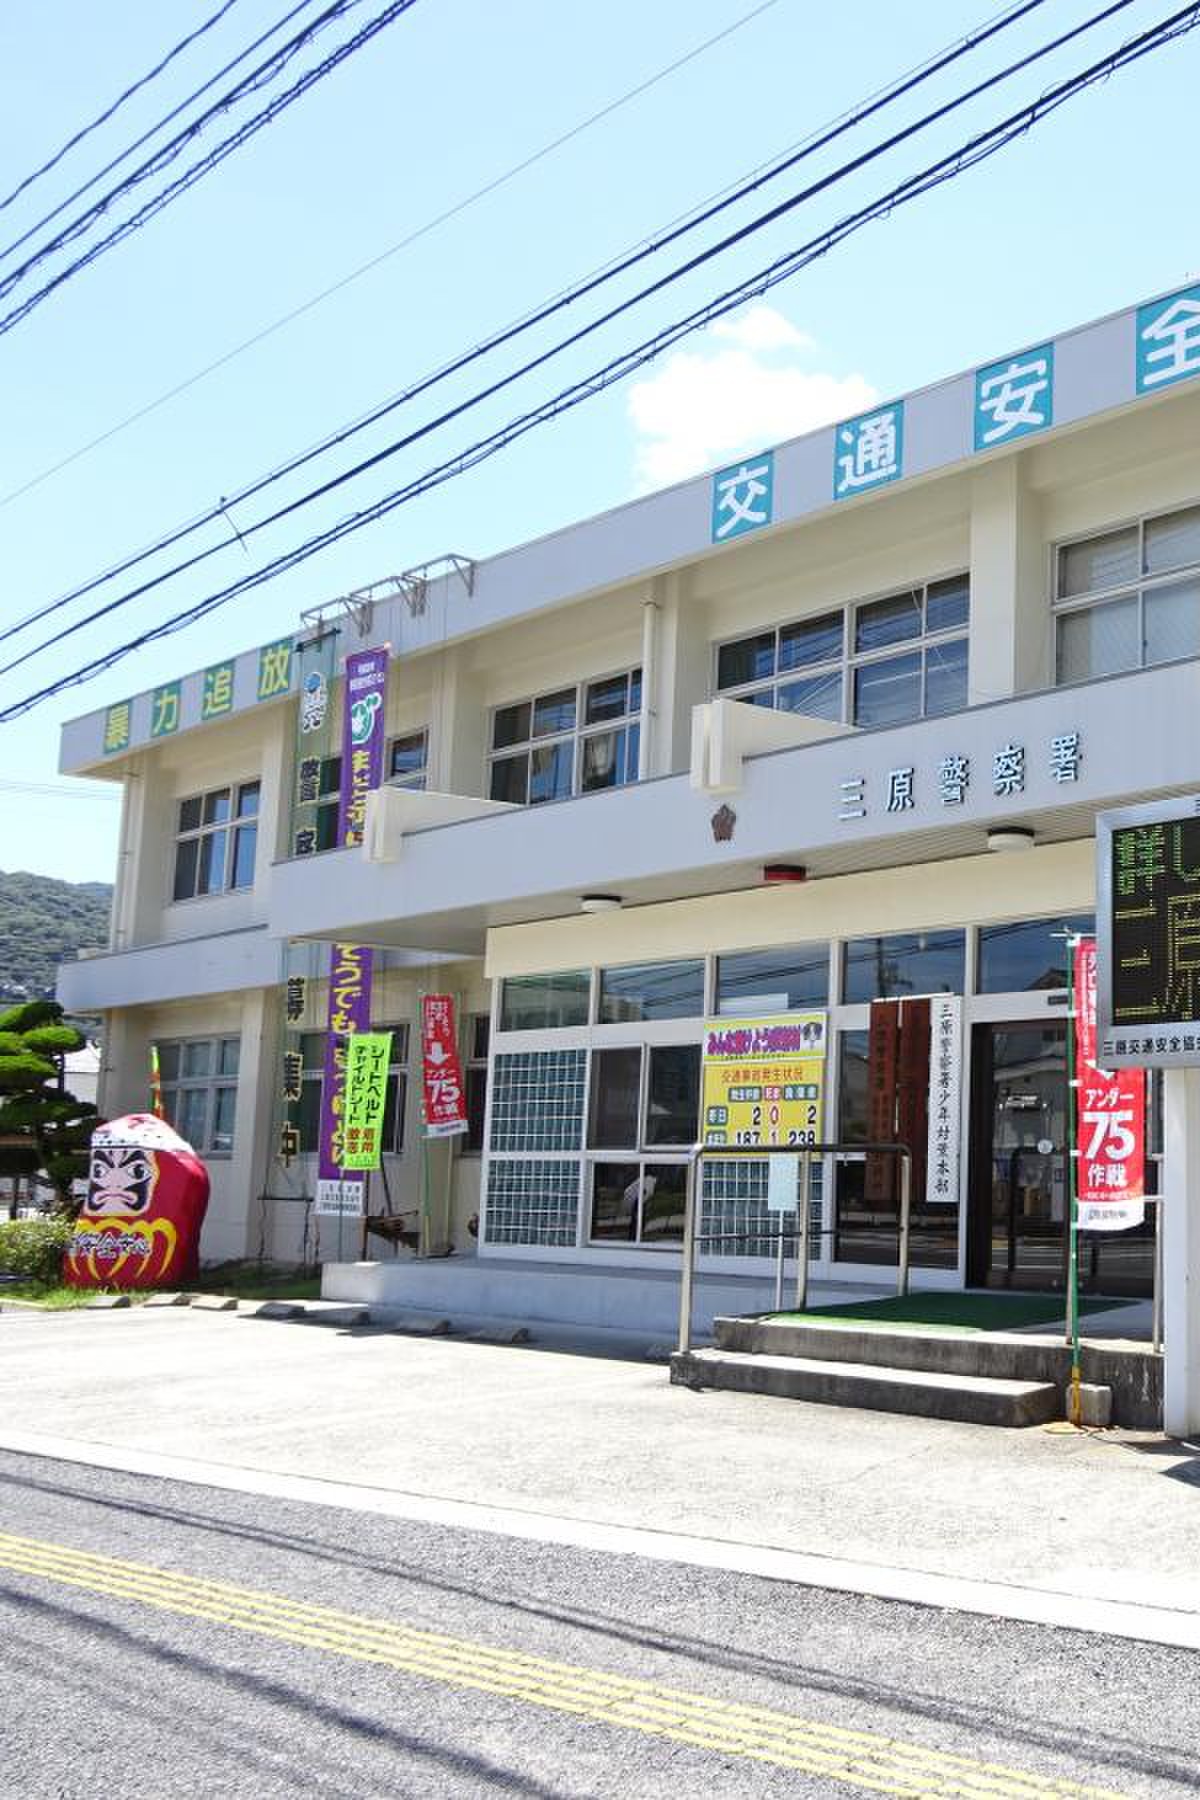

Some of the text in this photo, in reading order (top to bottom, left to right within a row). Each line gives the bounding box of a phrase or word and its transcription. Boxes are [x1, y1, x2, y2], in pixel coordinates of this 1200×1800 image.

[106, 644, 289, 748] 暴力追放
[839, 733, 1080, 821] 三原警察署
[427, 1078, 460, 1104] 75
[1084, 1086, 1135, 1109] アンダー
[752, 1106, 761, 1126] 2
[770, 1105, 779, 1125] 0
[807, 1105, 817, 1125] 2
[1082, 1110, 1136, 1161] 75
[1087, 1163, 1128, 1188] 作戦
